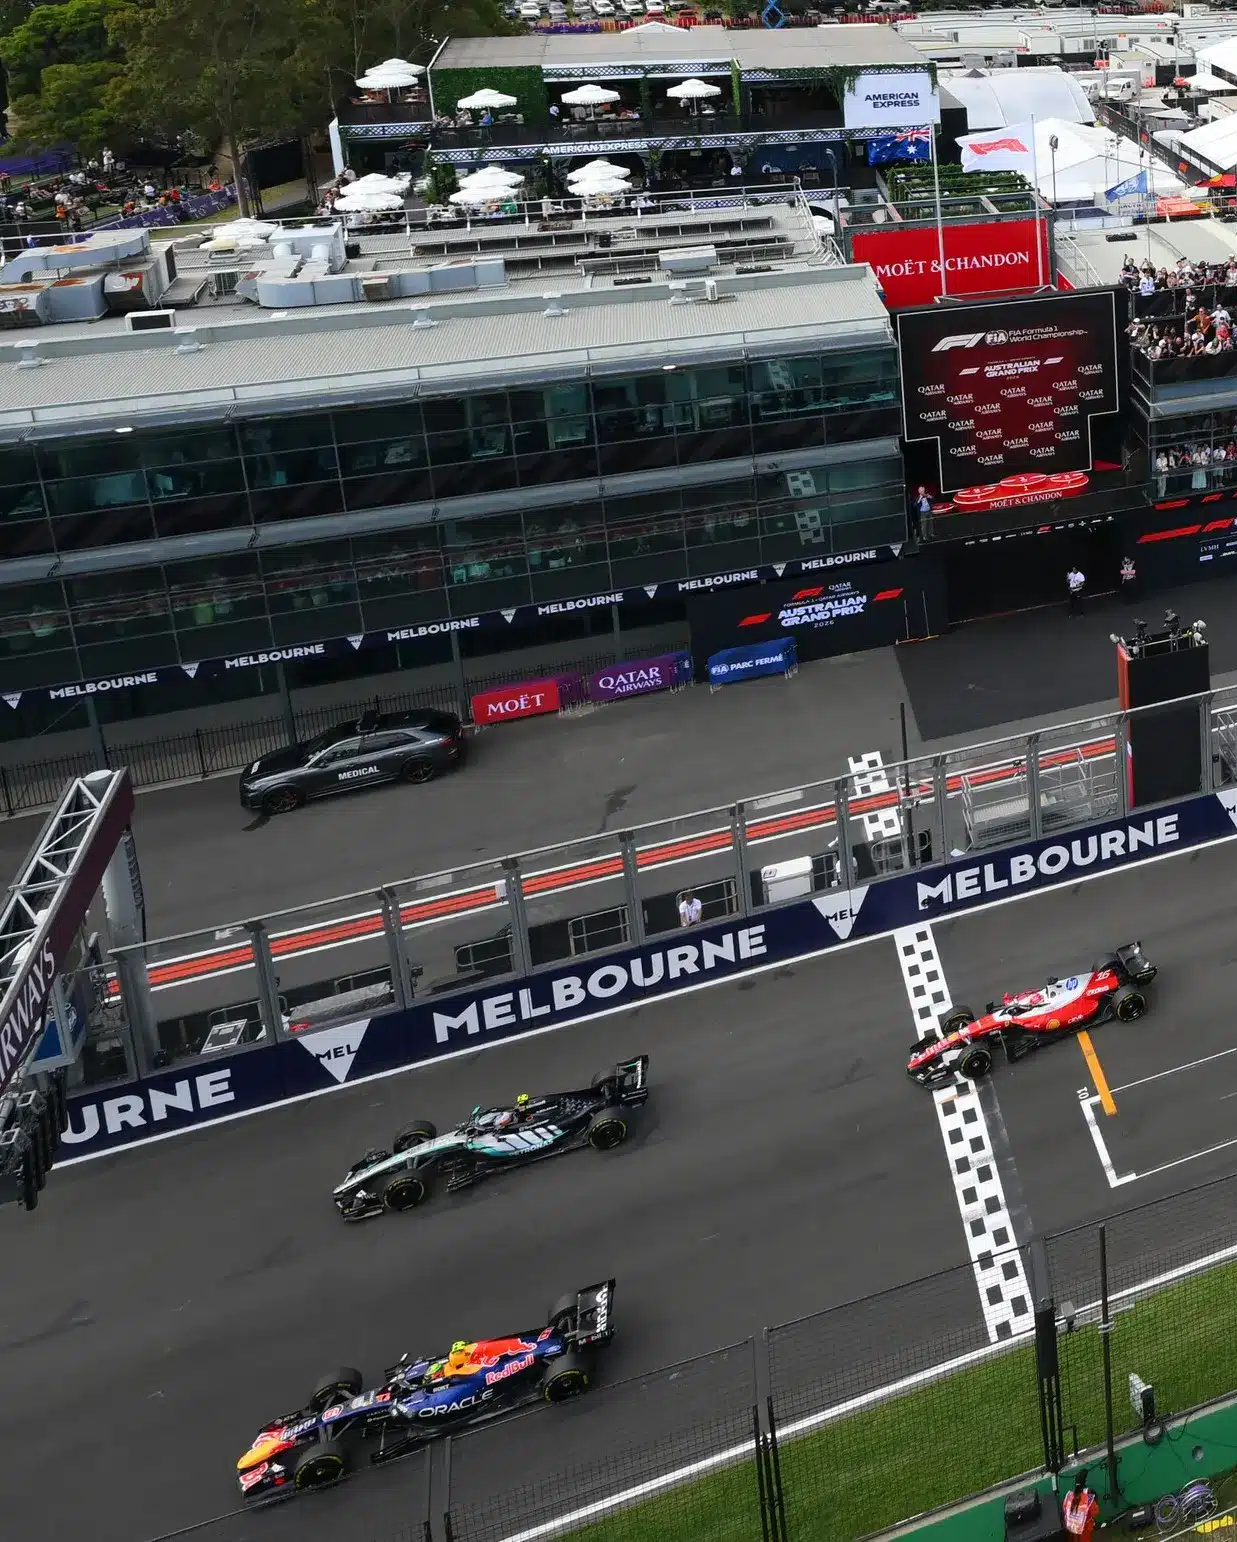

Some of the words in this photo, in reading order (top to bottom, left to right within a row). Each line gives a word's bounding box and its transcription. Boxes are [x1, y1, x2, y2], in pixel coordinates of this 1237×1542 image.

[864, 92, 919, 102] AMERICAN
[872, 100, 920, 109] EXPRESS
[542, 145, 598, 154] AMERICAN
[599, 142, 648, 152] EXPRESS
[876, 259, 926, 279] MOËT
[945, 251, 1030, 271] CHANDON
[1022, 326, 1053, 335] Formula
[1009, 335, 1032, 343] World
[984, 360, 1041, 372] AUSTRALIAN
[985, 368, 1016, 378] GRAND
[1017, 366, 1039, 374] PRIX
[1078, 364, 1103, 374] QATAR
[918, 384, 945, 394] QATAR
[1052, 380, 1078, 390] QATAR
[1000, 387, 1026, 397] QATAR
[1079, 389, 1104, 399] QATAR
[947, 394, 973, 403] QATAR
[1027, 396, 1053, 406] QATAR
[975, 403, 1000, 413] QATAR
[1054, 405, 1078, 415] QATAR
[920, 410, 946, 420] QATAR
[948, 420, 975, 429] QATAR
[1028, 421, 1054, 431] QATAR
[976, 429, 1002, 439] QATAR
[1055, 430, 1080, 440] QATAR
[1003, 438, 1029, 448] QATAR
[950, 445, 976, 455] QATAR
[1030, 446, 1055, 456] QATAR
[978, 454, 1003, 464] QATAR
[990, 498, 1013, 509] MOËT
[1022, 491, 1062, 504] CHANDON
[801, 549, 876, 572] MELBOURNE
[678, 569, 758, 592] MELBOURNE
[828, 582, 851, 590] QATAR
[538, 592, 624, 617] MELBOURNE
[778, 595, 867, 619] AUSTRALIAN
[781, 611, 831, 627] GRAND
[832, 604, 864, 617] PRIX
[387, 616, 480, 642] MELBOURNE
[225, 643, 325, 670] MELBOURNE
[711, 664, 729, 674] FIA
[731, 661, 753, 670] PARC
[755, 655, 783, 667] FERMÉ
[599, 666, 661, 691] QATAR
[50, 672, 158, 701] MELBOURNE
[614, 677, 662, 696] AIRWAYS
[487, 694, 544, 716] MOËT
[338, 765, 380, 781] MEDICAL
[918, 814, 1180, 909] MELBOURNE
[826, 909, 857, 922] MEL
[433, 924, 768, 1044] MELBOURNE
[0, 937, 54, 1085] IRWAYS
[315, 1044, 357, 1061] MEL
[60, 1068, 235, 1144] URNE
[418, 1388, 494, 1418] ORACLE
